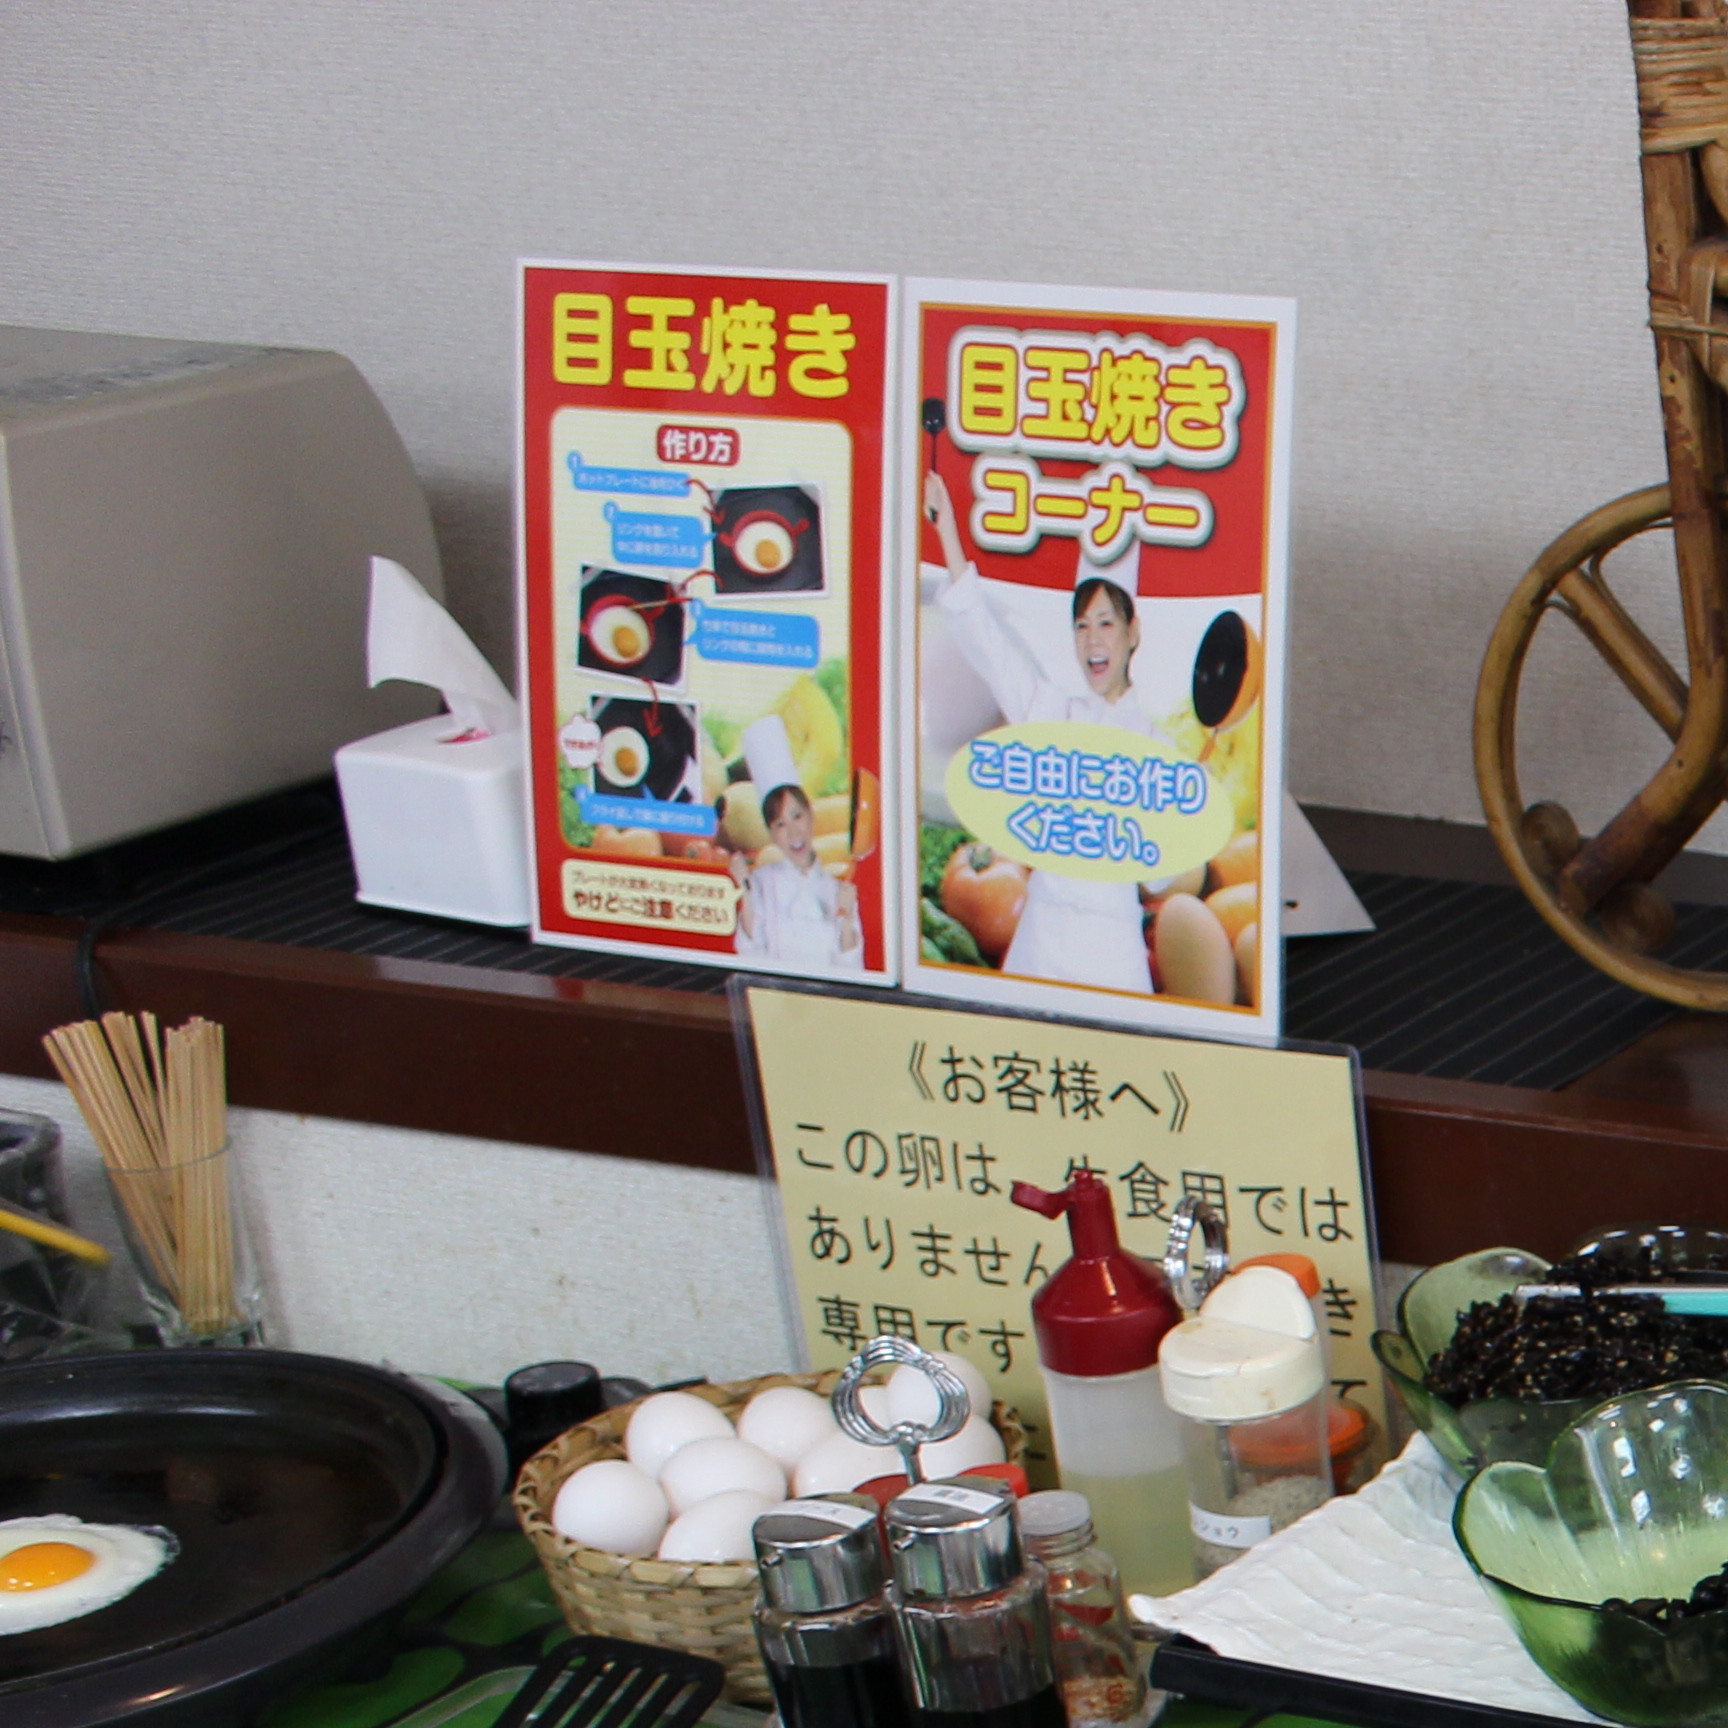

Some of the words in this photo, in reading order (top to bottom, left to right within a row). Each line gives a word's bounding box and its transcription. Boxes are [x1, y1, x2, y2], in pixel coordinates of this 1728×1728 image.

[550, 292, 857, 398] 目玉焼き
[958, 342, 1234, 453] 目玉焼き
[662, 429, 733, 463] 作り方
[980, 470, 1201, 547] コーナー
[967, 741, 1208, 814] ご自由にお作り
[1006, 803, 1161, 867] ください。
[906, 1040, 1193, 1134] 《お客様へ》
